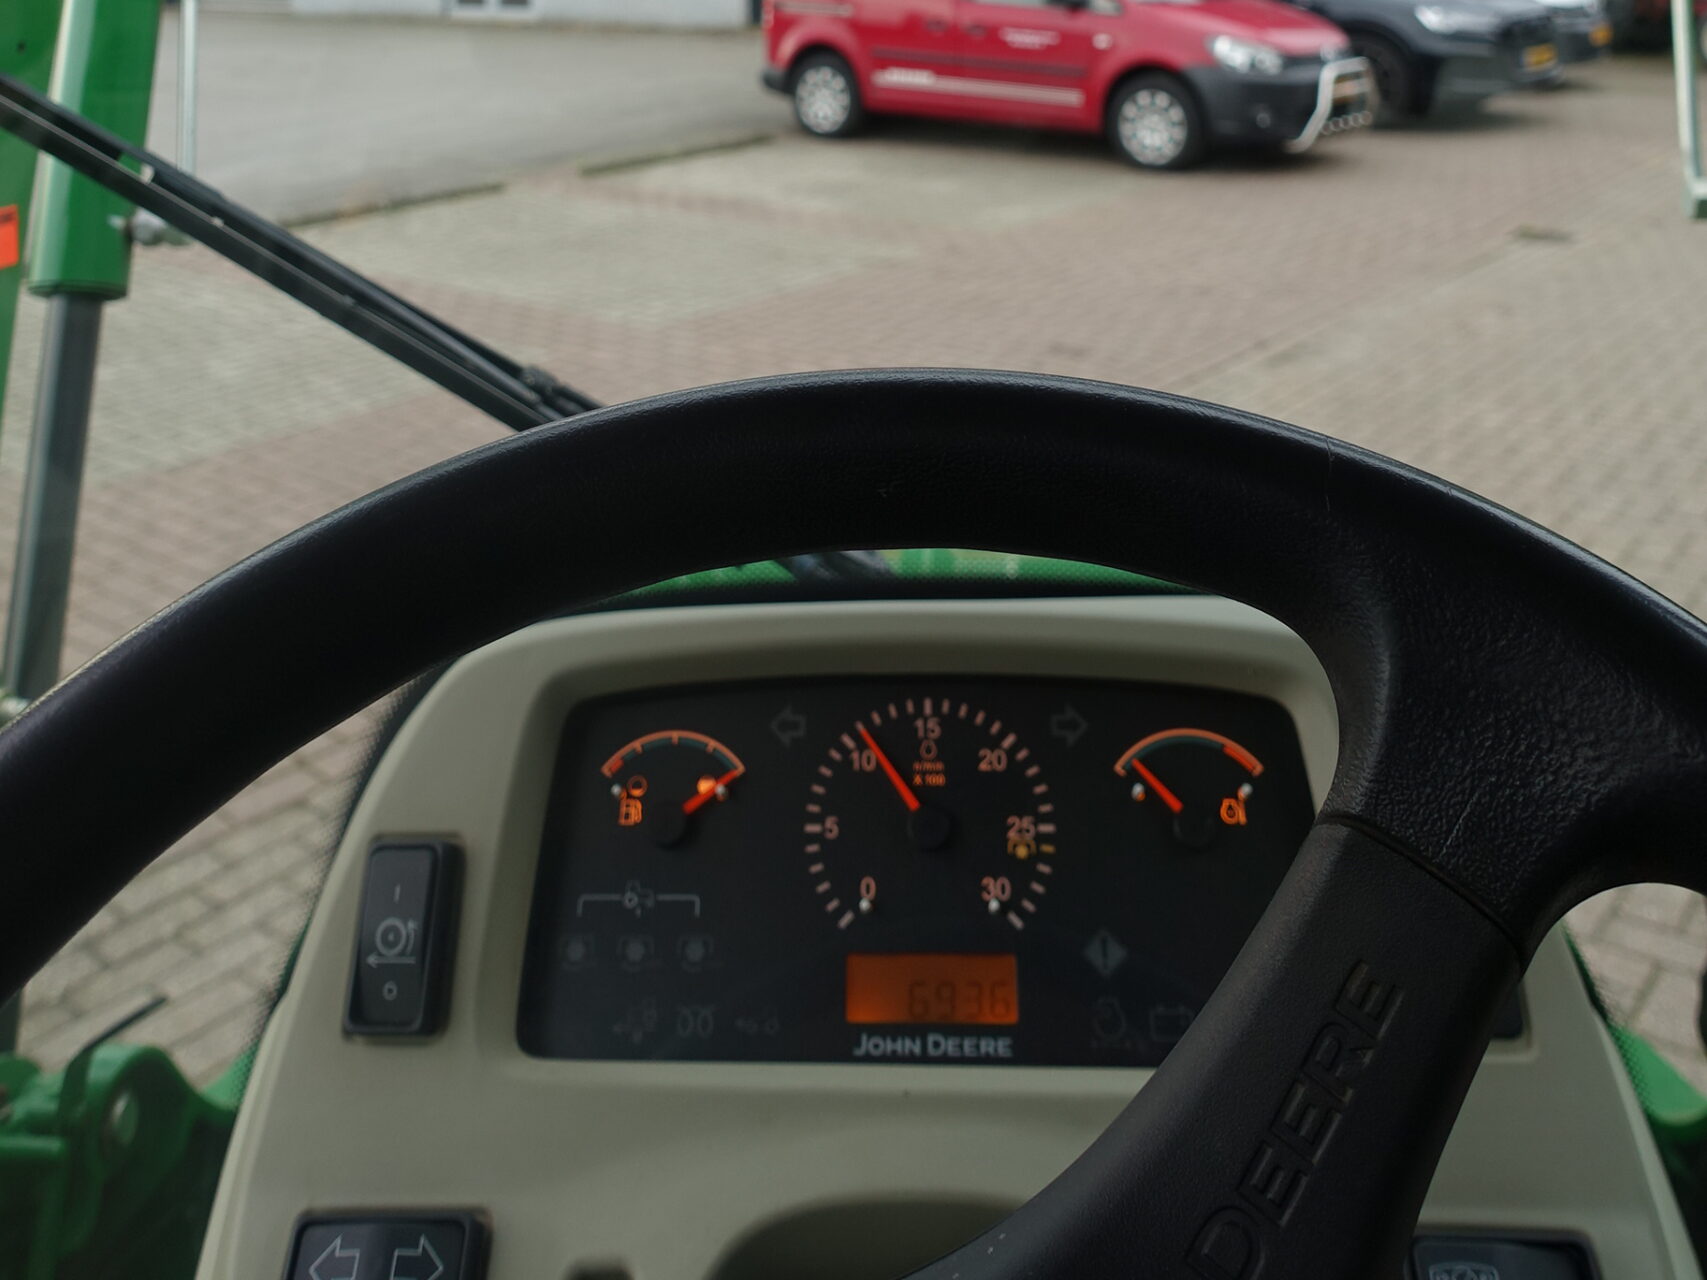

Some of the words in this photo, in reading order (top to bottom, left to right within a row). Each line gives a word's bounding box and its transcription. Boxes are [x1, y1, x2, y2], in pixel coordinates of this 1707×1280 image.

[914, 717, 942, 740] 15
[850, 749, 877, 771] 10
[978, 748, 1007, 772] 20
[823, 816, 839, 839] 5
[1006, 816, 1035, 840] 25
[860, 876, 876, 900] 0
[981, 876, 1012, 902] 30
[907, 980, 1012, 1020] 6936
[1185, 958, 1404, 1279] DEERE
